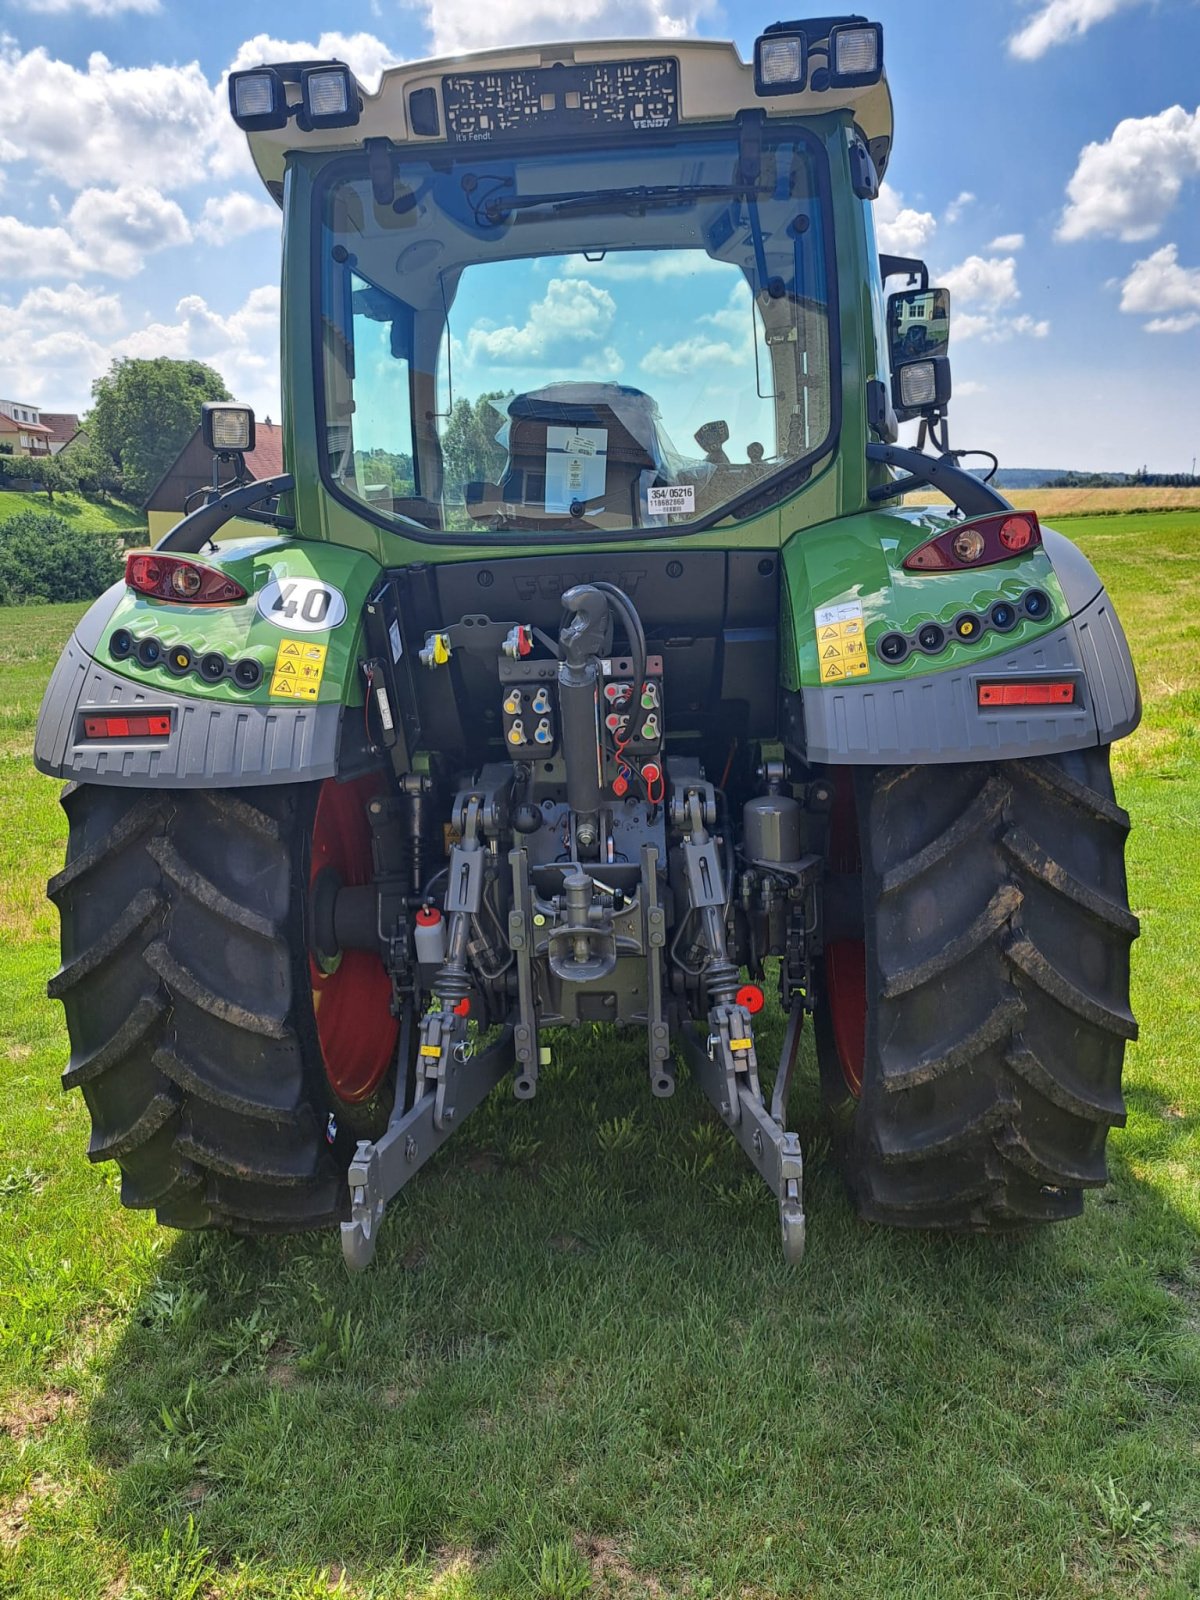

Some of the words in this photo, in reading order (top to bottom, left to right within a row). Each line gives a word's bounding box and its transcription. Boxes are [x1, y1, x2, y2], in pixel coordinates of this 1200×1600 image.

[633, 118, 671, 129] FENDT
[456, 132, 467, 142] It's
[271, 583, 332, 623] 40
